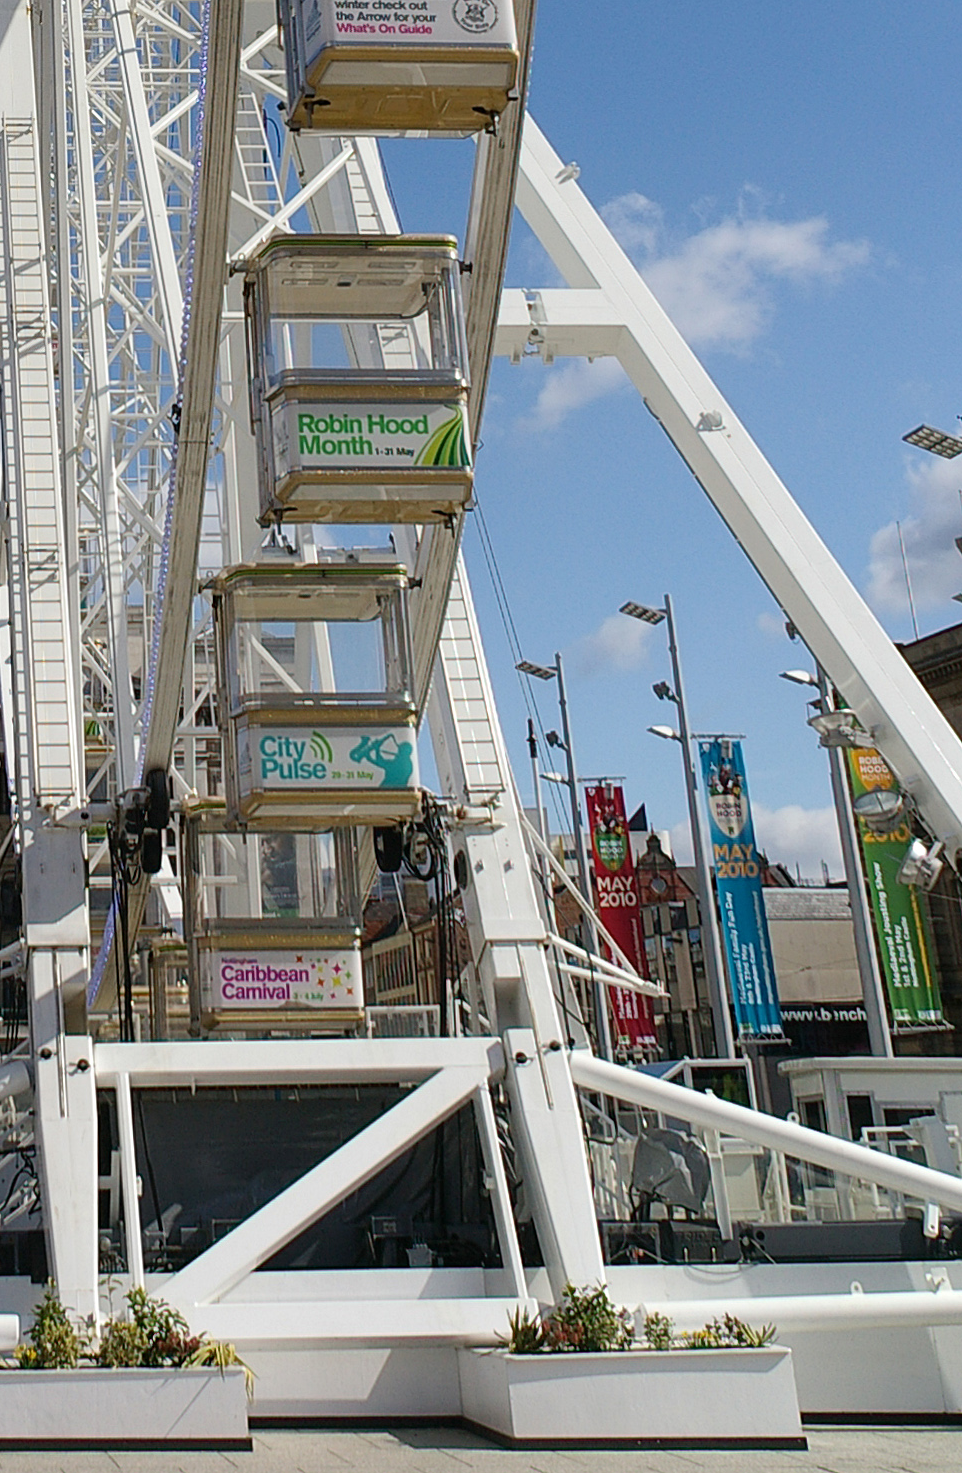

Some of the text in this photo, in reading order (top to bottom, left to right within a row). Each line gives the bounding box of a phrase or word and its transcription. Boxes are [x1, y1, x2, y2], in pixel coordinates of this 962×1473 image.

[335, 0, 428, 11] winter check out
[336, 11, 437, 24] the Arrow for your
[337, 23, 433, 35] What's On Guide
[298, 413, 429, 435] Robin Hood
[299, 435, 373, 455] Month
[396, 447, 415, 458] May
[259, 735, 306, 762] City
[261, 758, 327, 780] Pulse
[357, 771, 374, 781] May
[860, 765, 890, 774] HOOD
[717, 810, 742, 818] HOOD
[712, 843, 754, 862] MAY
[716, 861, 759, 879] 2010
[873, 861, 884, 890] Show
[597, 875, 633, 892] MAY
[599, 891, 637, 908] 2010
[724, 891, 733, 910] Day
[879, 890, 893, 935] Jousting
[729, 929, 740, 959] Family
[741, 943, 749, 961] May
[221, 957, 258, 966] Nottingham
[894, 924, 912, 988] 1st & 2nd May
[221, 965, 310, 983] Caribbean
[221, 983, 291, 1001] Carnival
[311, 992, 324, 1002] July
